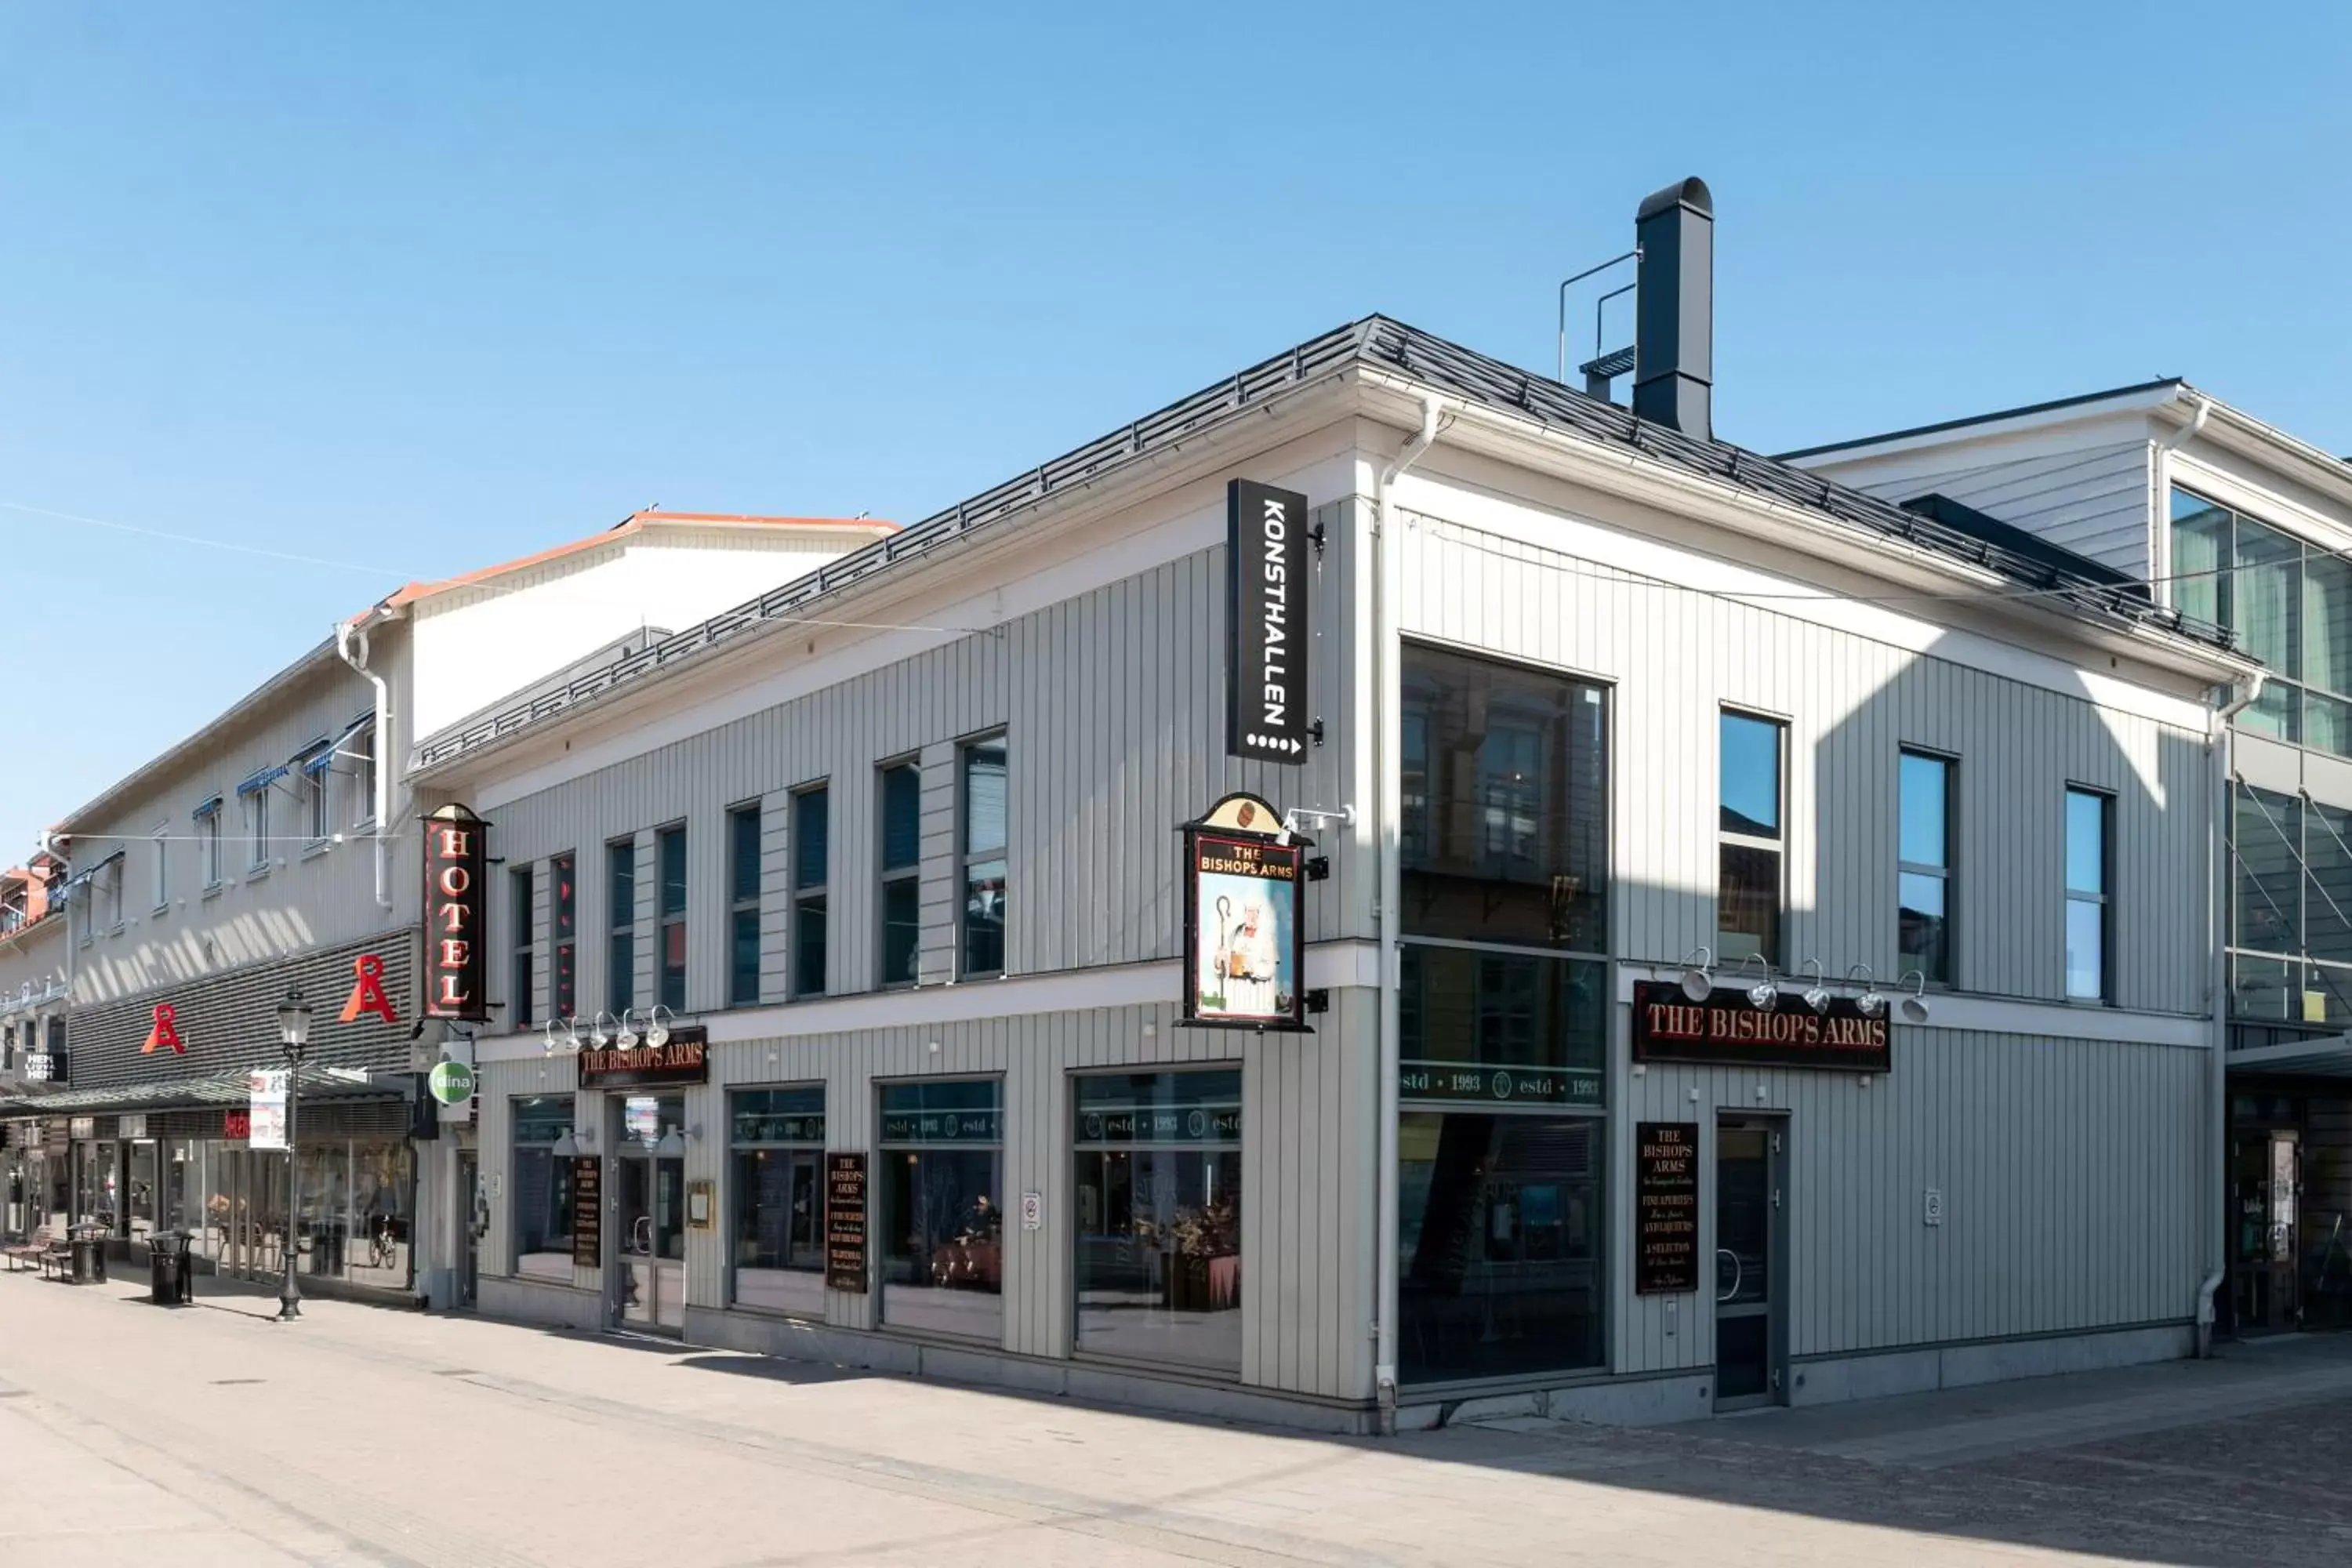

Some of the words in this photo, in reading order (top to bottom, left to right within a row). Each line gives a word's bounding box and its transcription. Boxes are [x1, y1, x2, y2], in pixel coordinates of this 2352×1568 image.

[1264, 499, 1286, 726] KONSTHALLEN
[1233, 847, 1261, 860] THE
[1201, 857, 1258, 875] BISHOPS
[439, 829, 470, 1004] HOTEL
[1648, 1004, 1704, 1036] THE
[1710, 1007, 1819, 1044] BISHOPS
[1821, 1017, 1886, 1047] ARMS
[583, 1049, 606, 1072] THE
[608, 1046, 663, 1070] BISHOPS
[665, 1040, 703, 1065] ARMS
[437, 1075, 470, 1088] dina
[1452, 1073, 1481, 1092] 1993
[1520, 1078, 1552, 1094] estd
[1108, 1116, 1136, 1132] estd
[1657, 1130, 1681, 1143] THE
[1643, 1145, 1693, 1158] BISHOPS
[1653, 1160, 1686, 1174] ARMS
